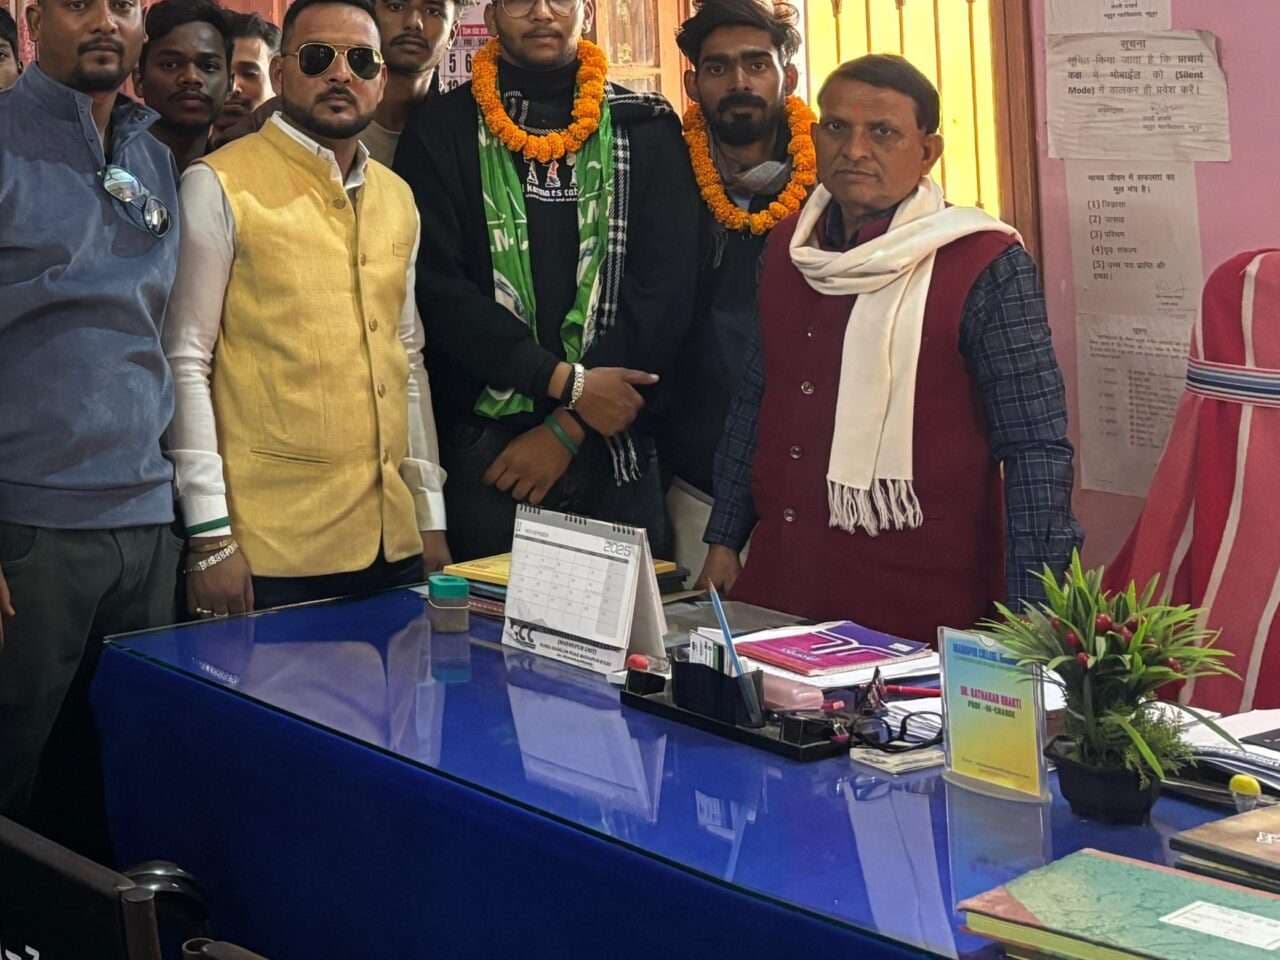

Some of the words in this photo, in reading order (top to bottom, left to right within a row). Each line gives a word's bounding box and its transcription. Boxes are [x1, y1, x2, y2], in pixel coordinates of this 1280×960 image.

[449, 53, 457, 74] 5
[465, 53, 472, 74] 6
[603, 540, 631, 557] 2025
